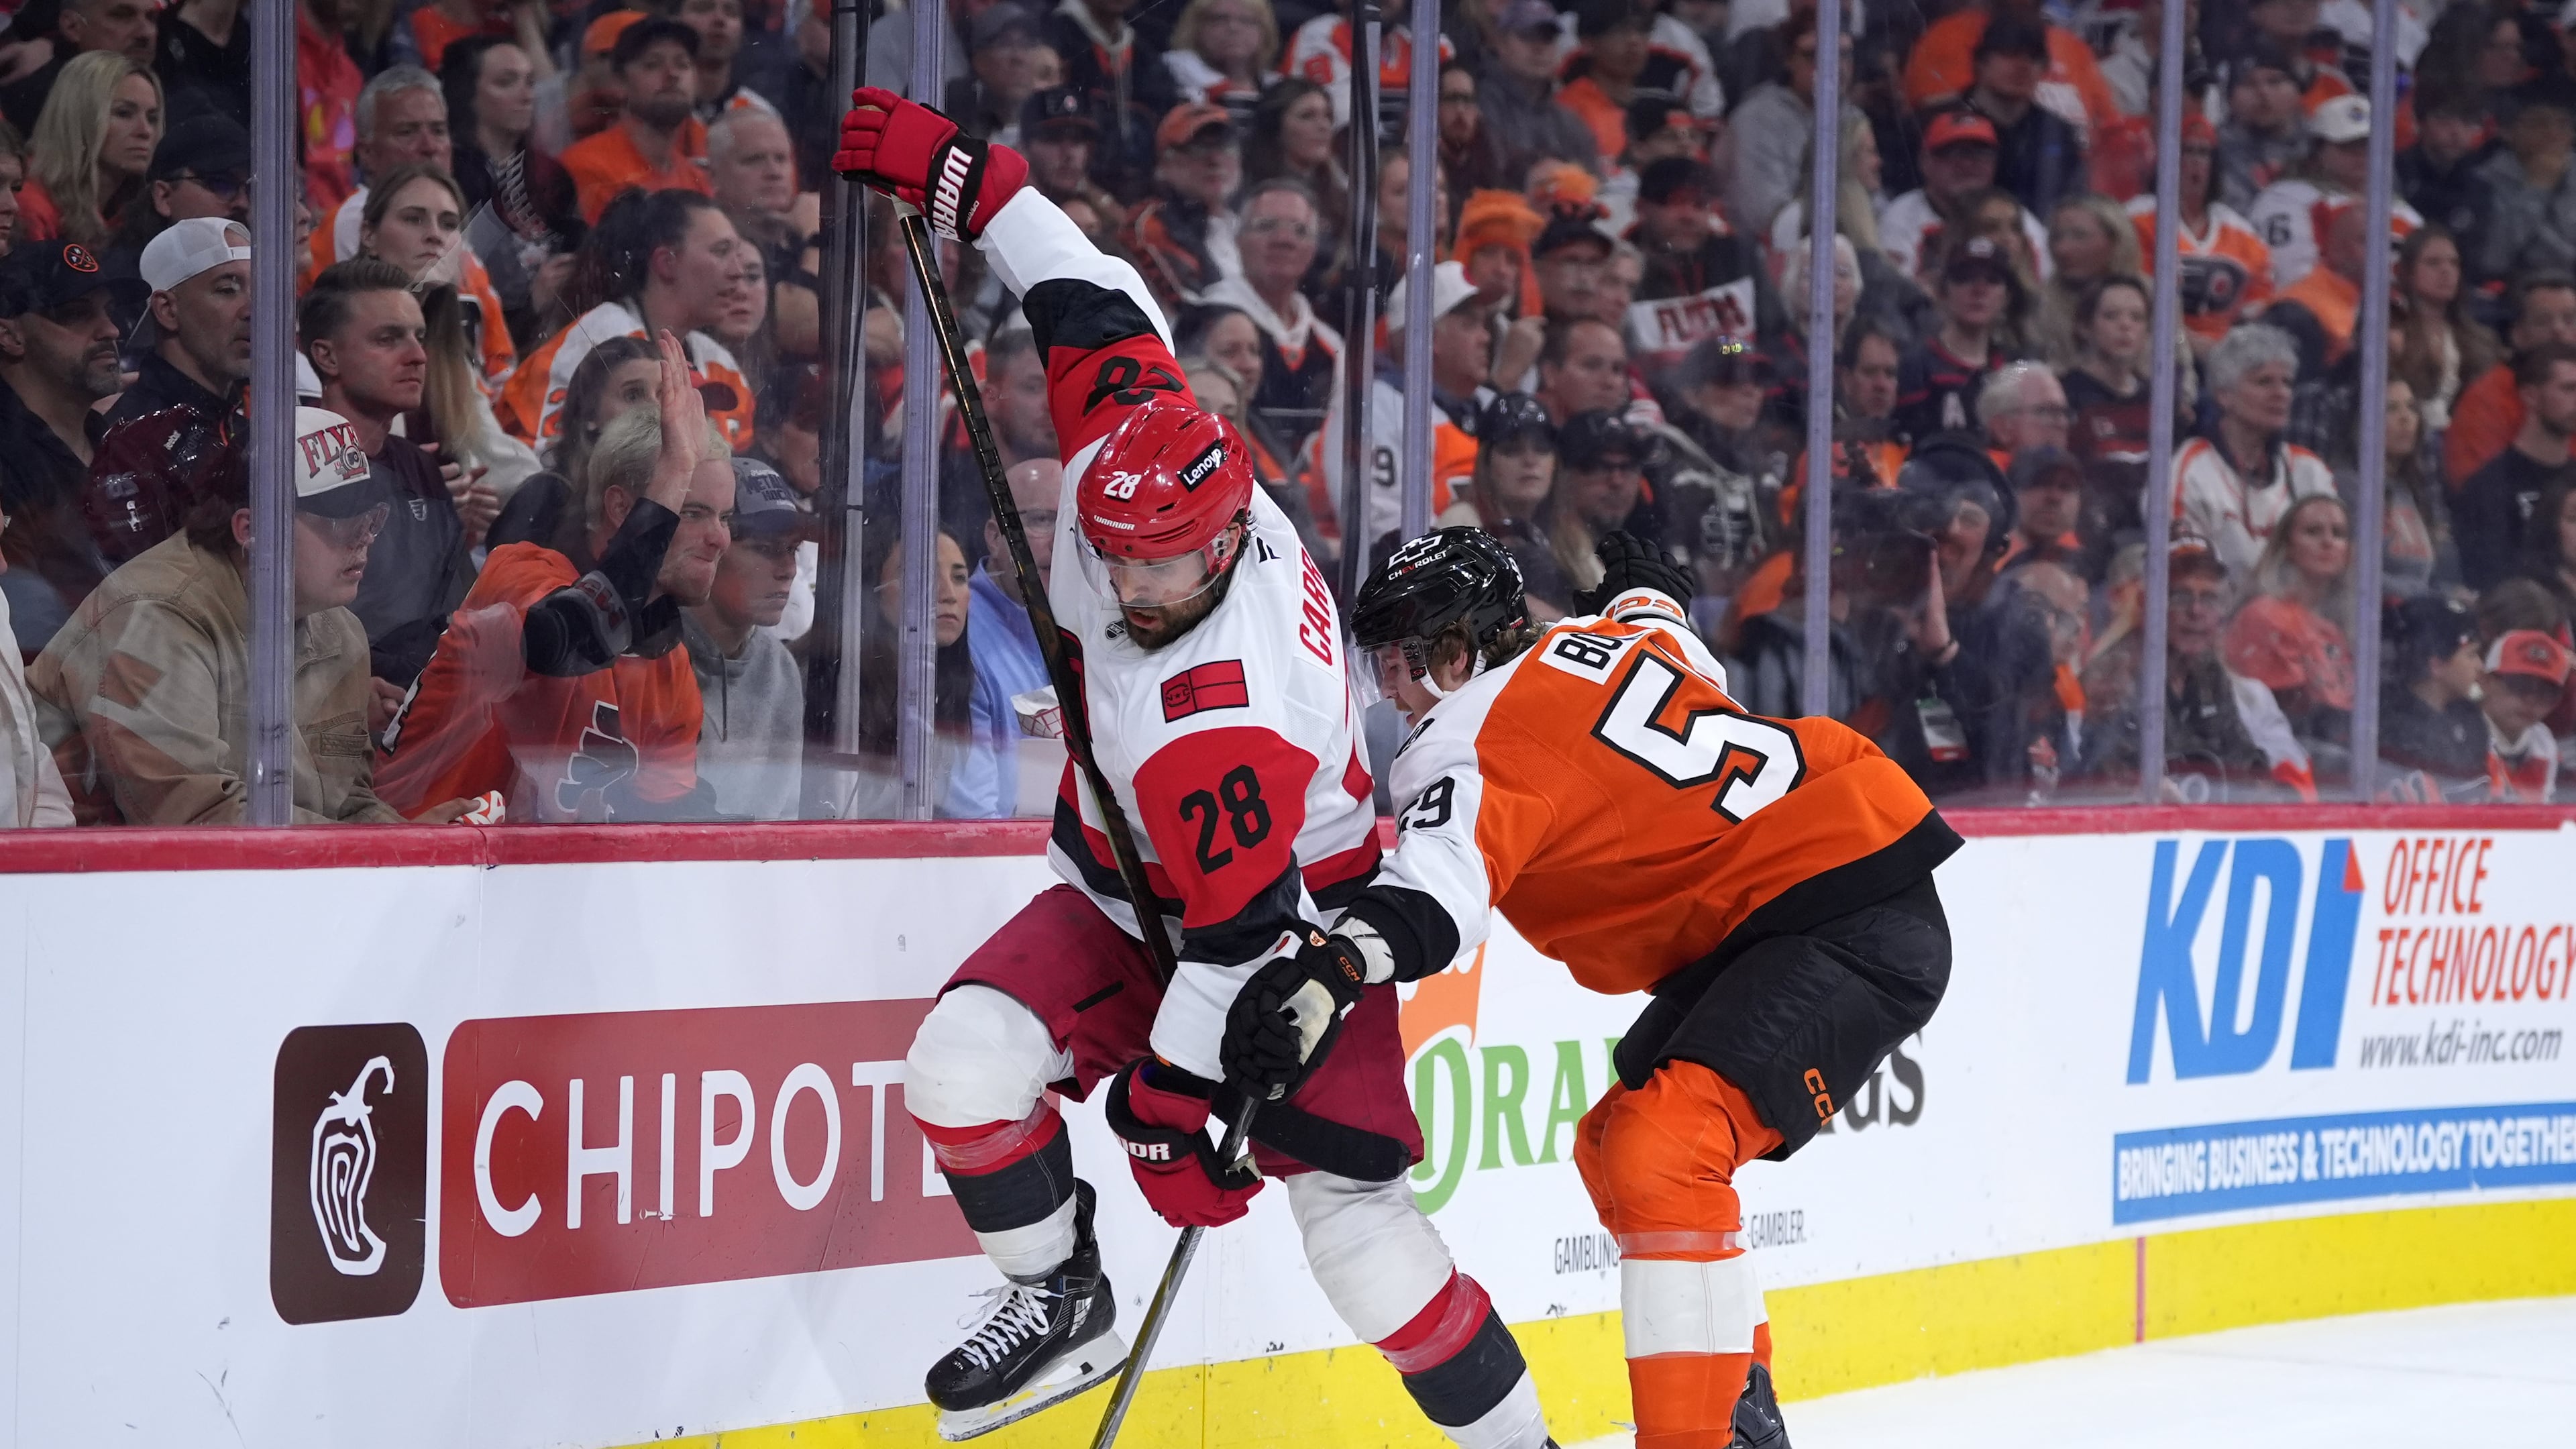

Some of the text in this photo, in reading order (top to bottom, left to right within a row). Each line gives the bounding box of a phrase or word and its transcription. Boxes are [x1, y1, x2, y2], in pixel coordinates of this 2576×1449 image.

[1093, 515, 1135, 531] WARRIOR
[1104, 471, 1142, 500] 28
[1388, 550, 1448, 581] CHEVROLET
[1590, 648, 1807, 826] 5
[1179, 764, 1272, 875] 28
[2384, 838, 2493, 916] OFFICE
[1339, 956, 1360, 981] CCM
[2126, 839, 2364, 1085] KDI
[2372, 924, 2576, 1006] TECHNOLOGY
[2360, 1020, 2563, 1069] www.kdi-inc.com
[2118, 1142, 2206, 1200] BRINGING
[2210, 1130, 2299, 1191] BUSINESS
[2302, 1130, 2320, 1181] &
[2320, 1120, 2469, 1181] TECHNOLOGY
